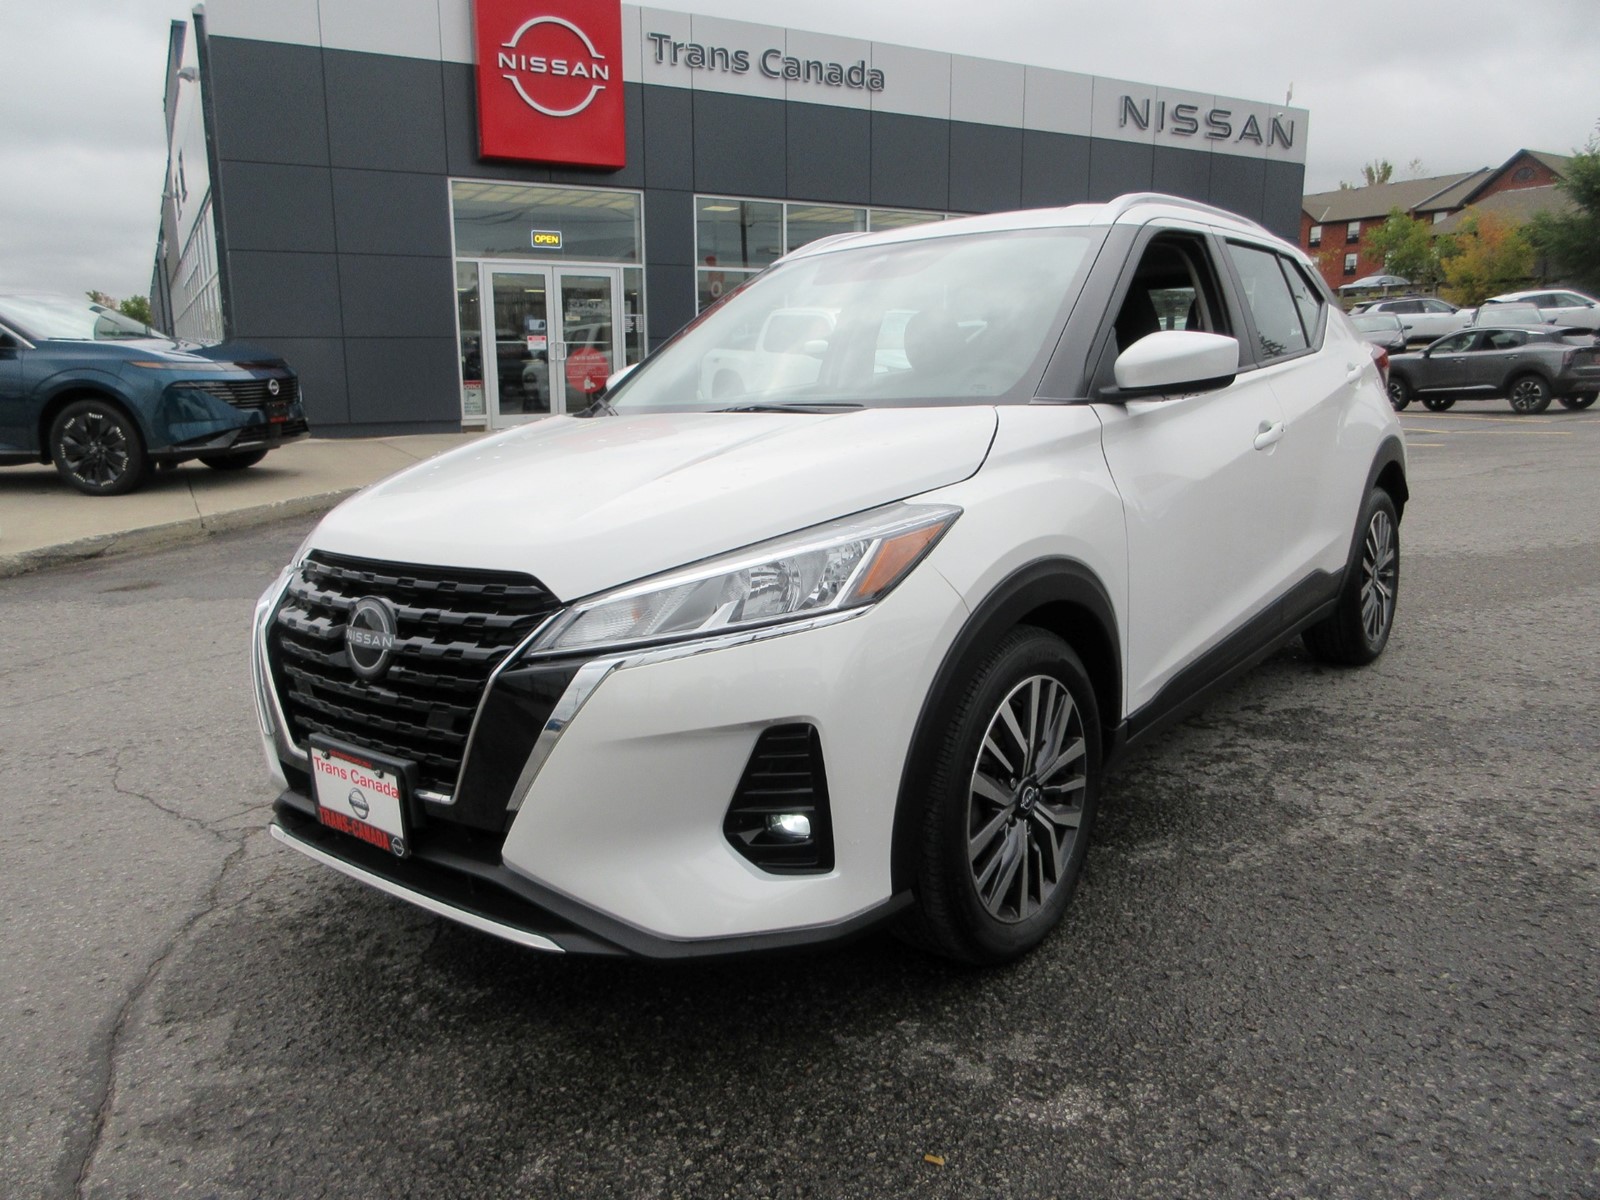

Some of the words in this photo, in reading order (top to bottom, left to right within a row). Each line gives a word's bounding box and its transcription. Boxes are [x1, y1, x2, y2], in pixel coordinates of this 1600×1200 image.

[498, 52, 609, 81] NISSAN
[647, 32, 750, 73] Trans
[758, 49, 885, 91] Canada
[1120, 95, 1295, 149] NISSAN
[534, 235, 559, 244] OPEN
[346, 628, 392, 647] NISSAN
[313, 756, 348, 780] Trans
[350, 769, 400, 799] Canada
[319, 807, 390, 851] TRANS-CANADA
